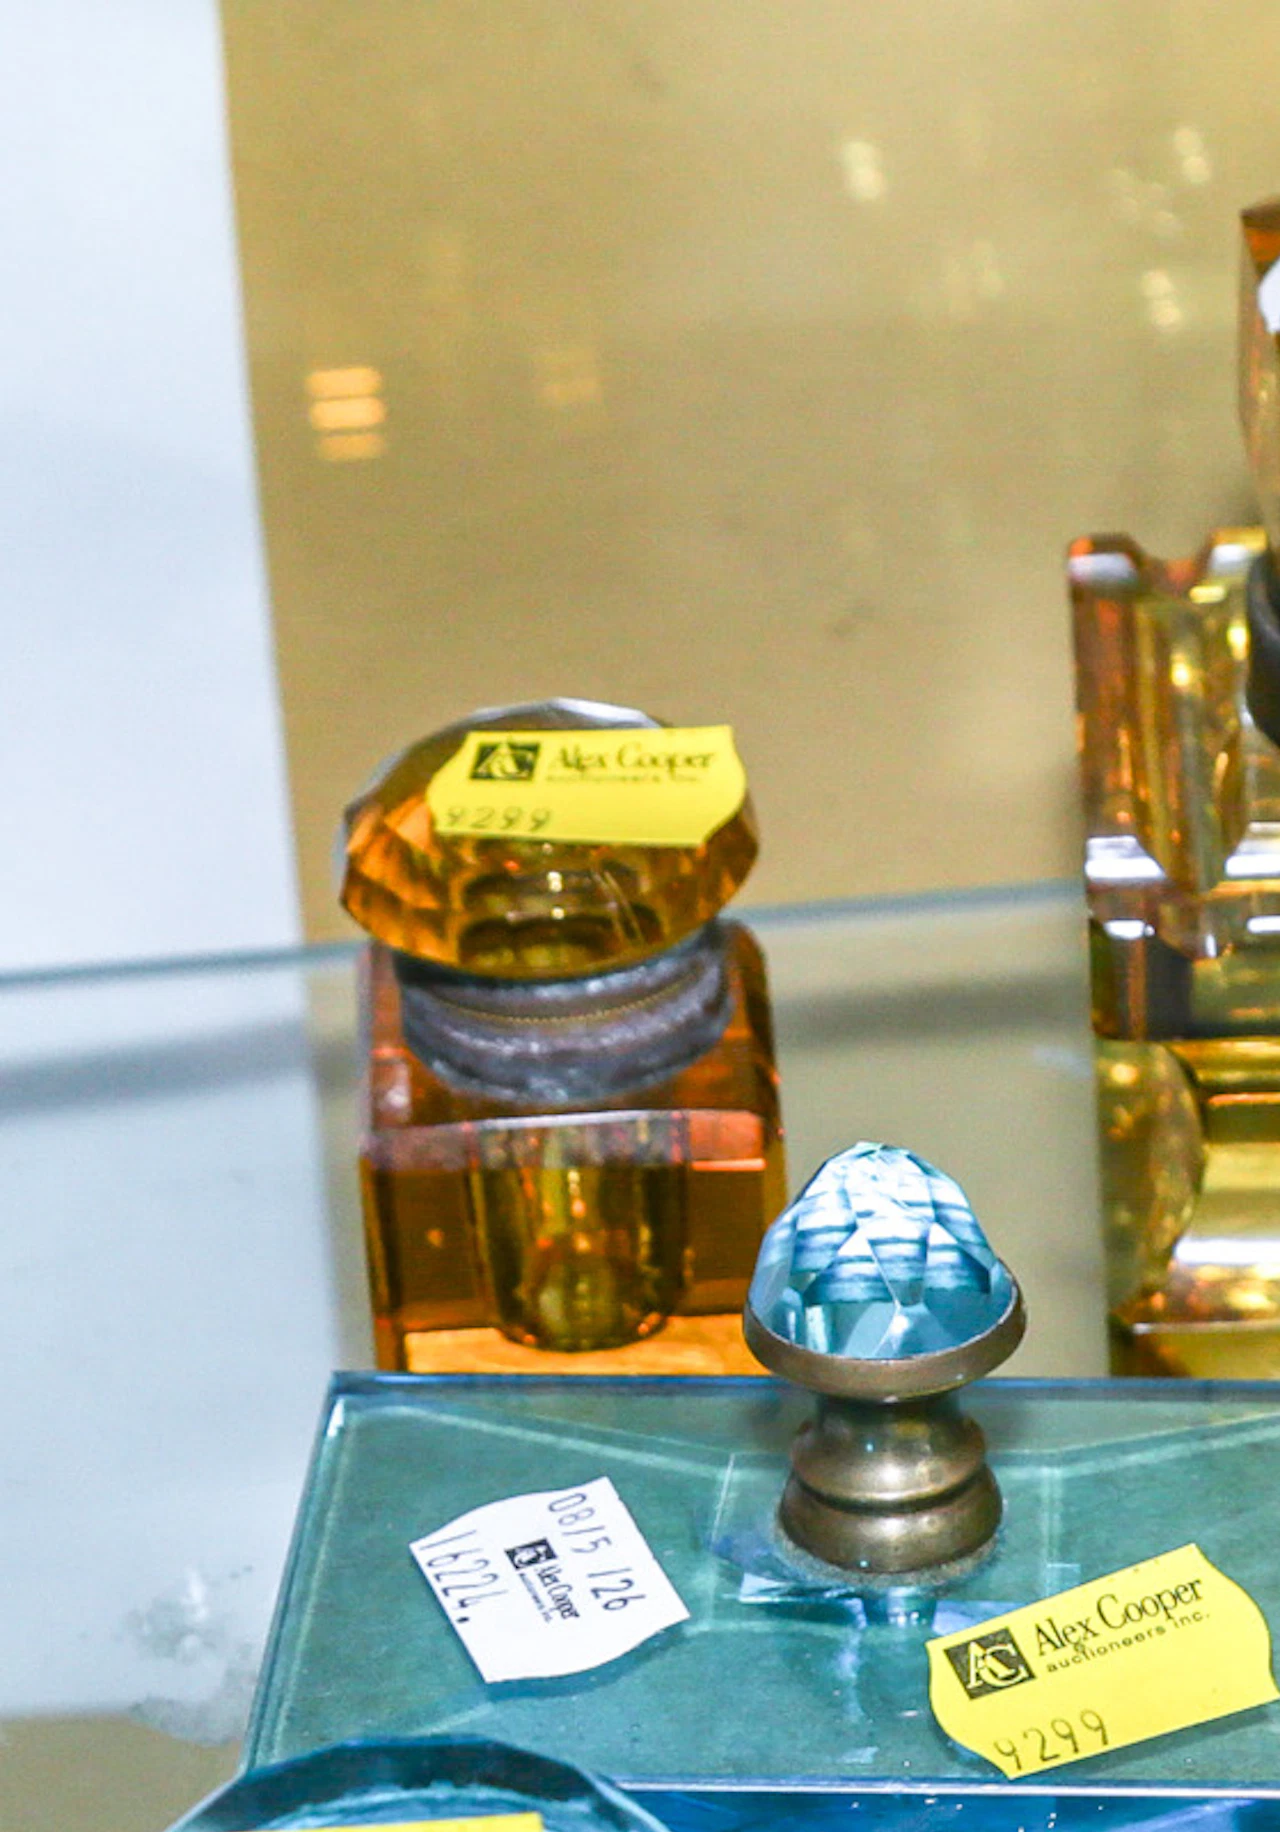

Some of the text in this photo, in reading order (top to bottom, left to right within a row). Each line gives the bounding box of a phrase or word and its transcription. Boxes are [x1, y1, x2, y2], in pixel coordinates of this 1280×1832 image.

[551, 742, 716, 773] Alex Cooper
[535, 1564, 562, 1588] Alex
[547, 1583, 580, 1620] Cooper
[1037, 1578, 1203, 1656] Alex Cooper
[1047, 1611, 1211, 1673] auctioneers inc.
